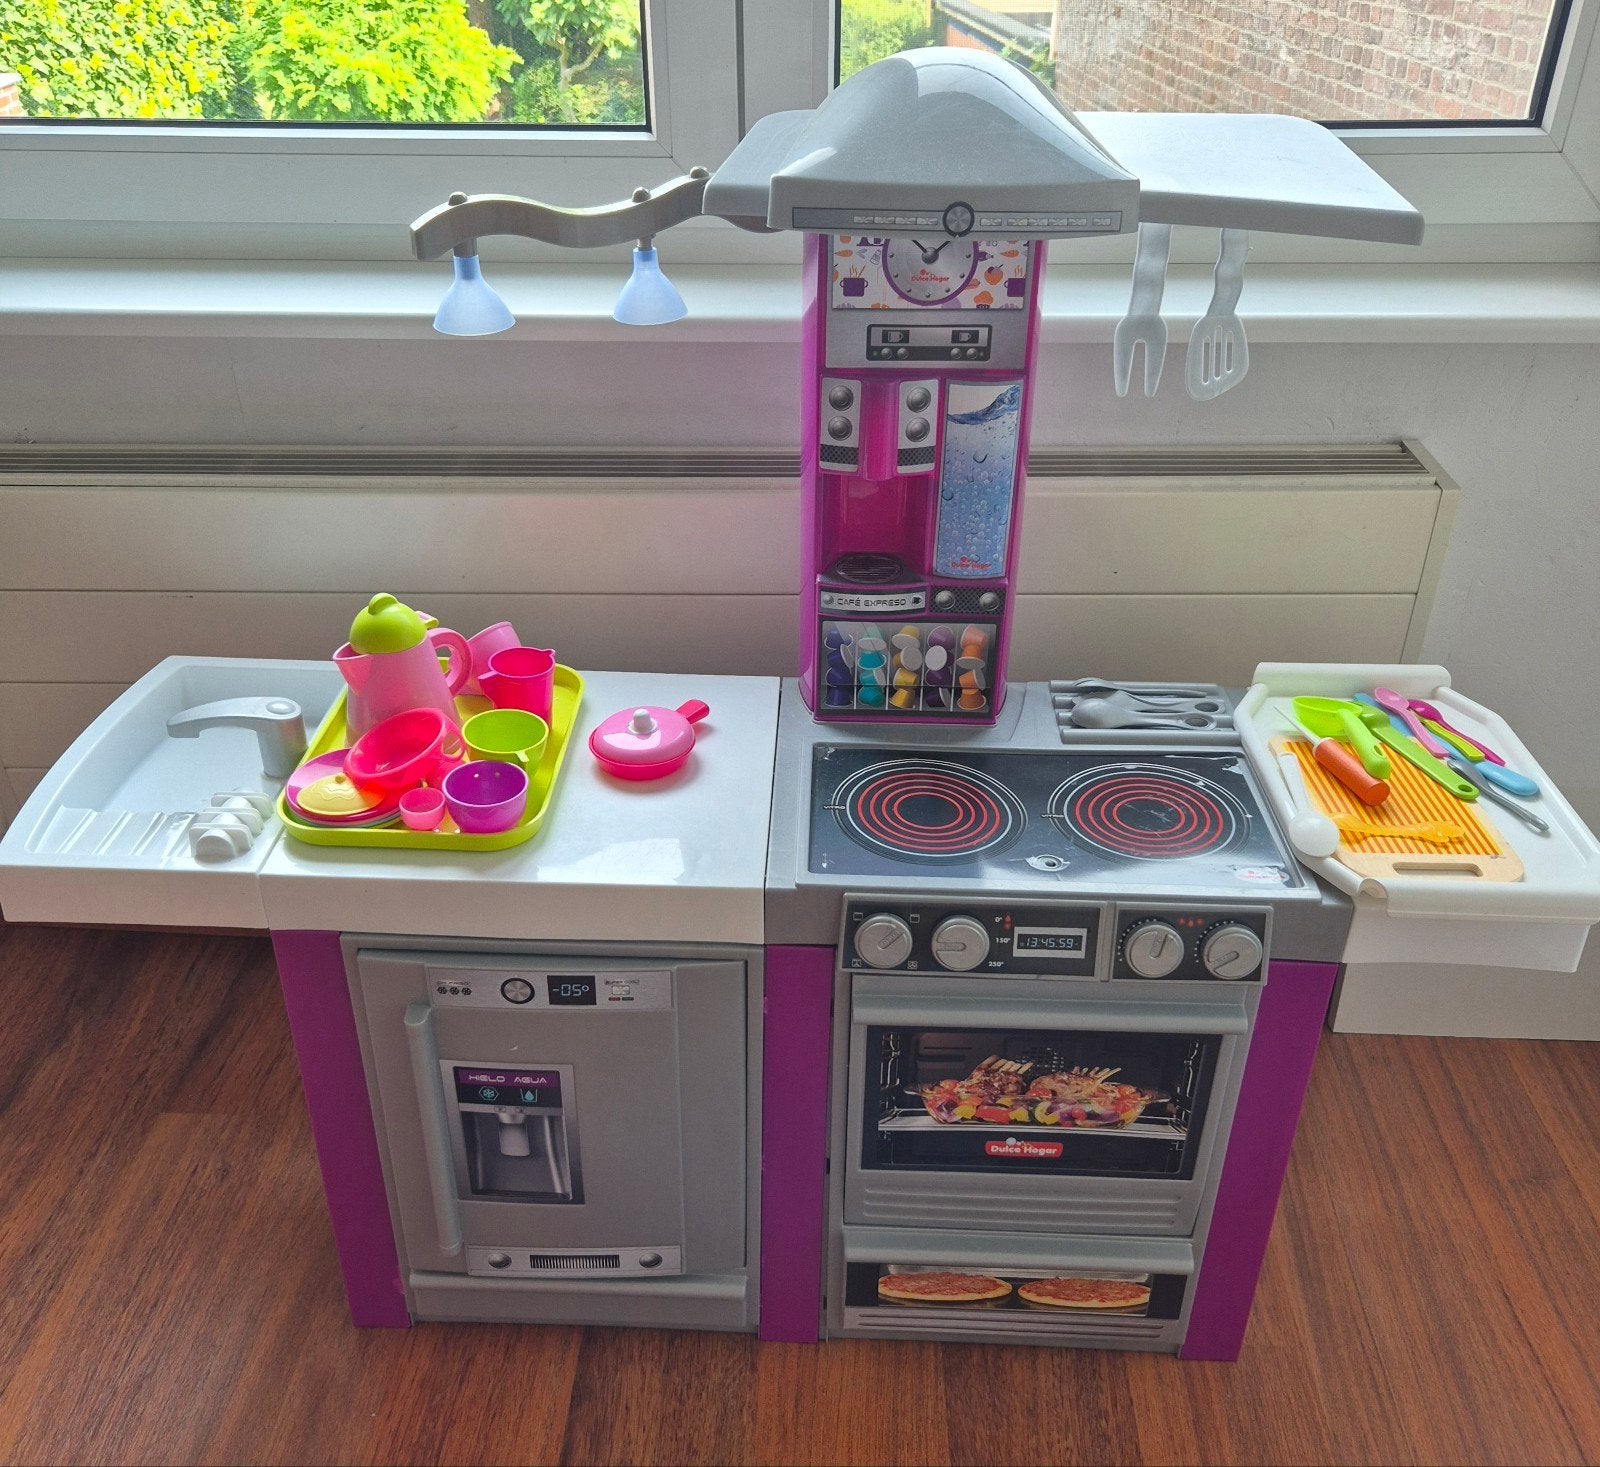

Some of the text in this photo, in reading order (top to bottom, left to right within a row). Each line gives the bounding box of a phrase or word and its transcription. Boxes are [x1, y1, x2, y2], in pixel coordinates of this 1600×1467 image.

[837, 597, 907, 607] CAFÉ EXPRESO
[468, 1074, 547, 1084] HIELO AGUA
[990, 1145, 1058, 1156] Dulce Hogar
